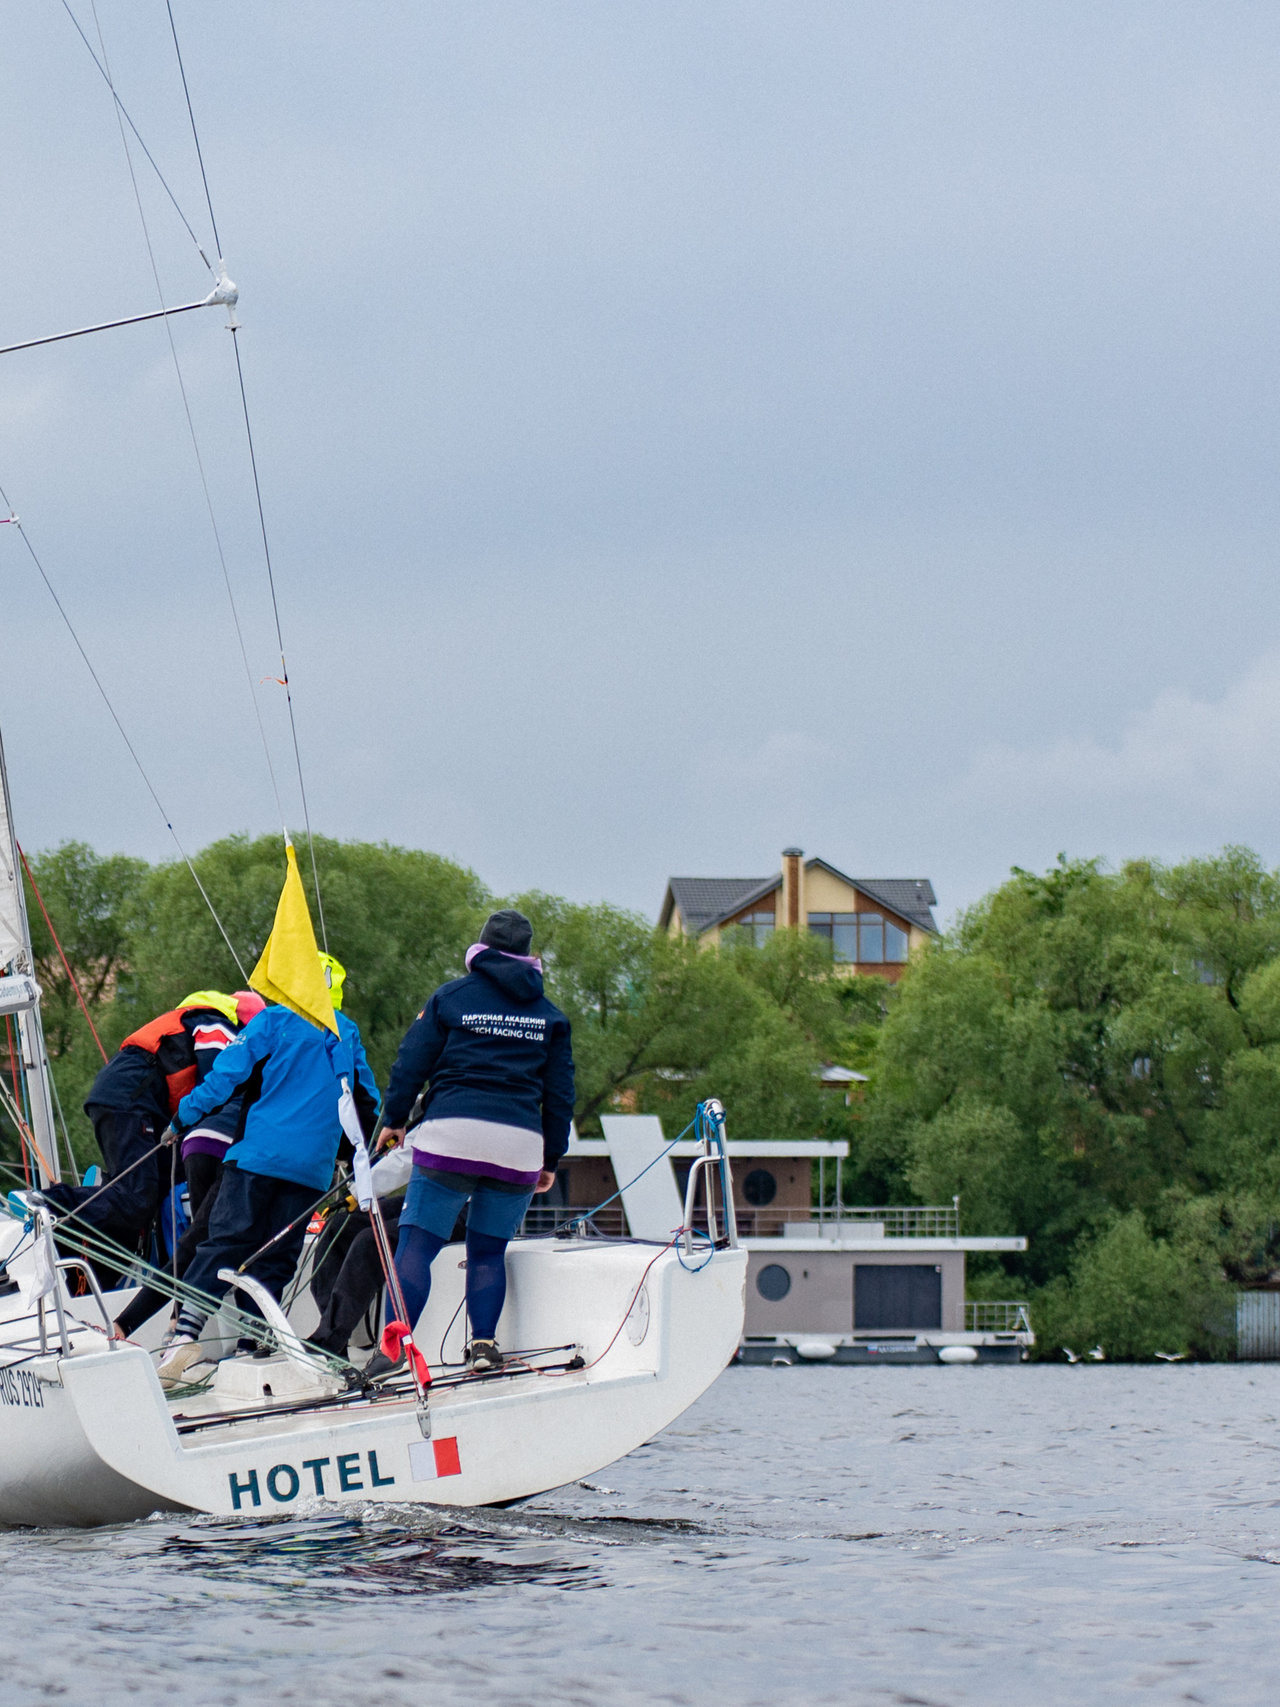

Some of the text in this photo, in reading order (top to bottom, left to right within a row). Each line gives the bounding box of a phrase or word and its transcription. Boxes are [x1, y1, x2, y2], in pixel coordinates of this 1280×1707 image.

[504, 1015, 545, 1025] АКАДЕМИЯ
[493, 1027, 523, 1039] RACING
[524, 1031, 545, 1041] CLUB
[228, 1449, 396, 1511] HOTEL
